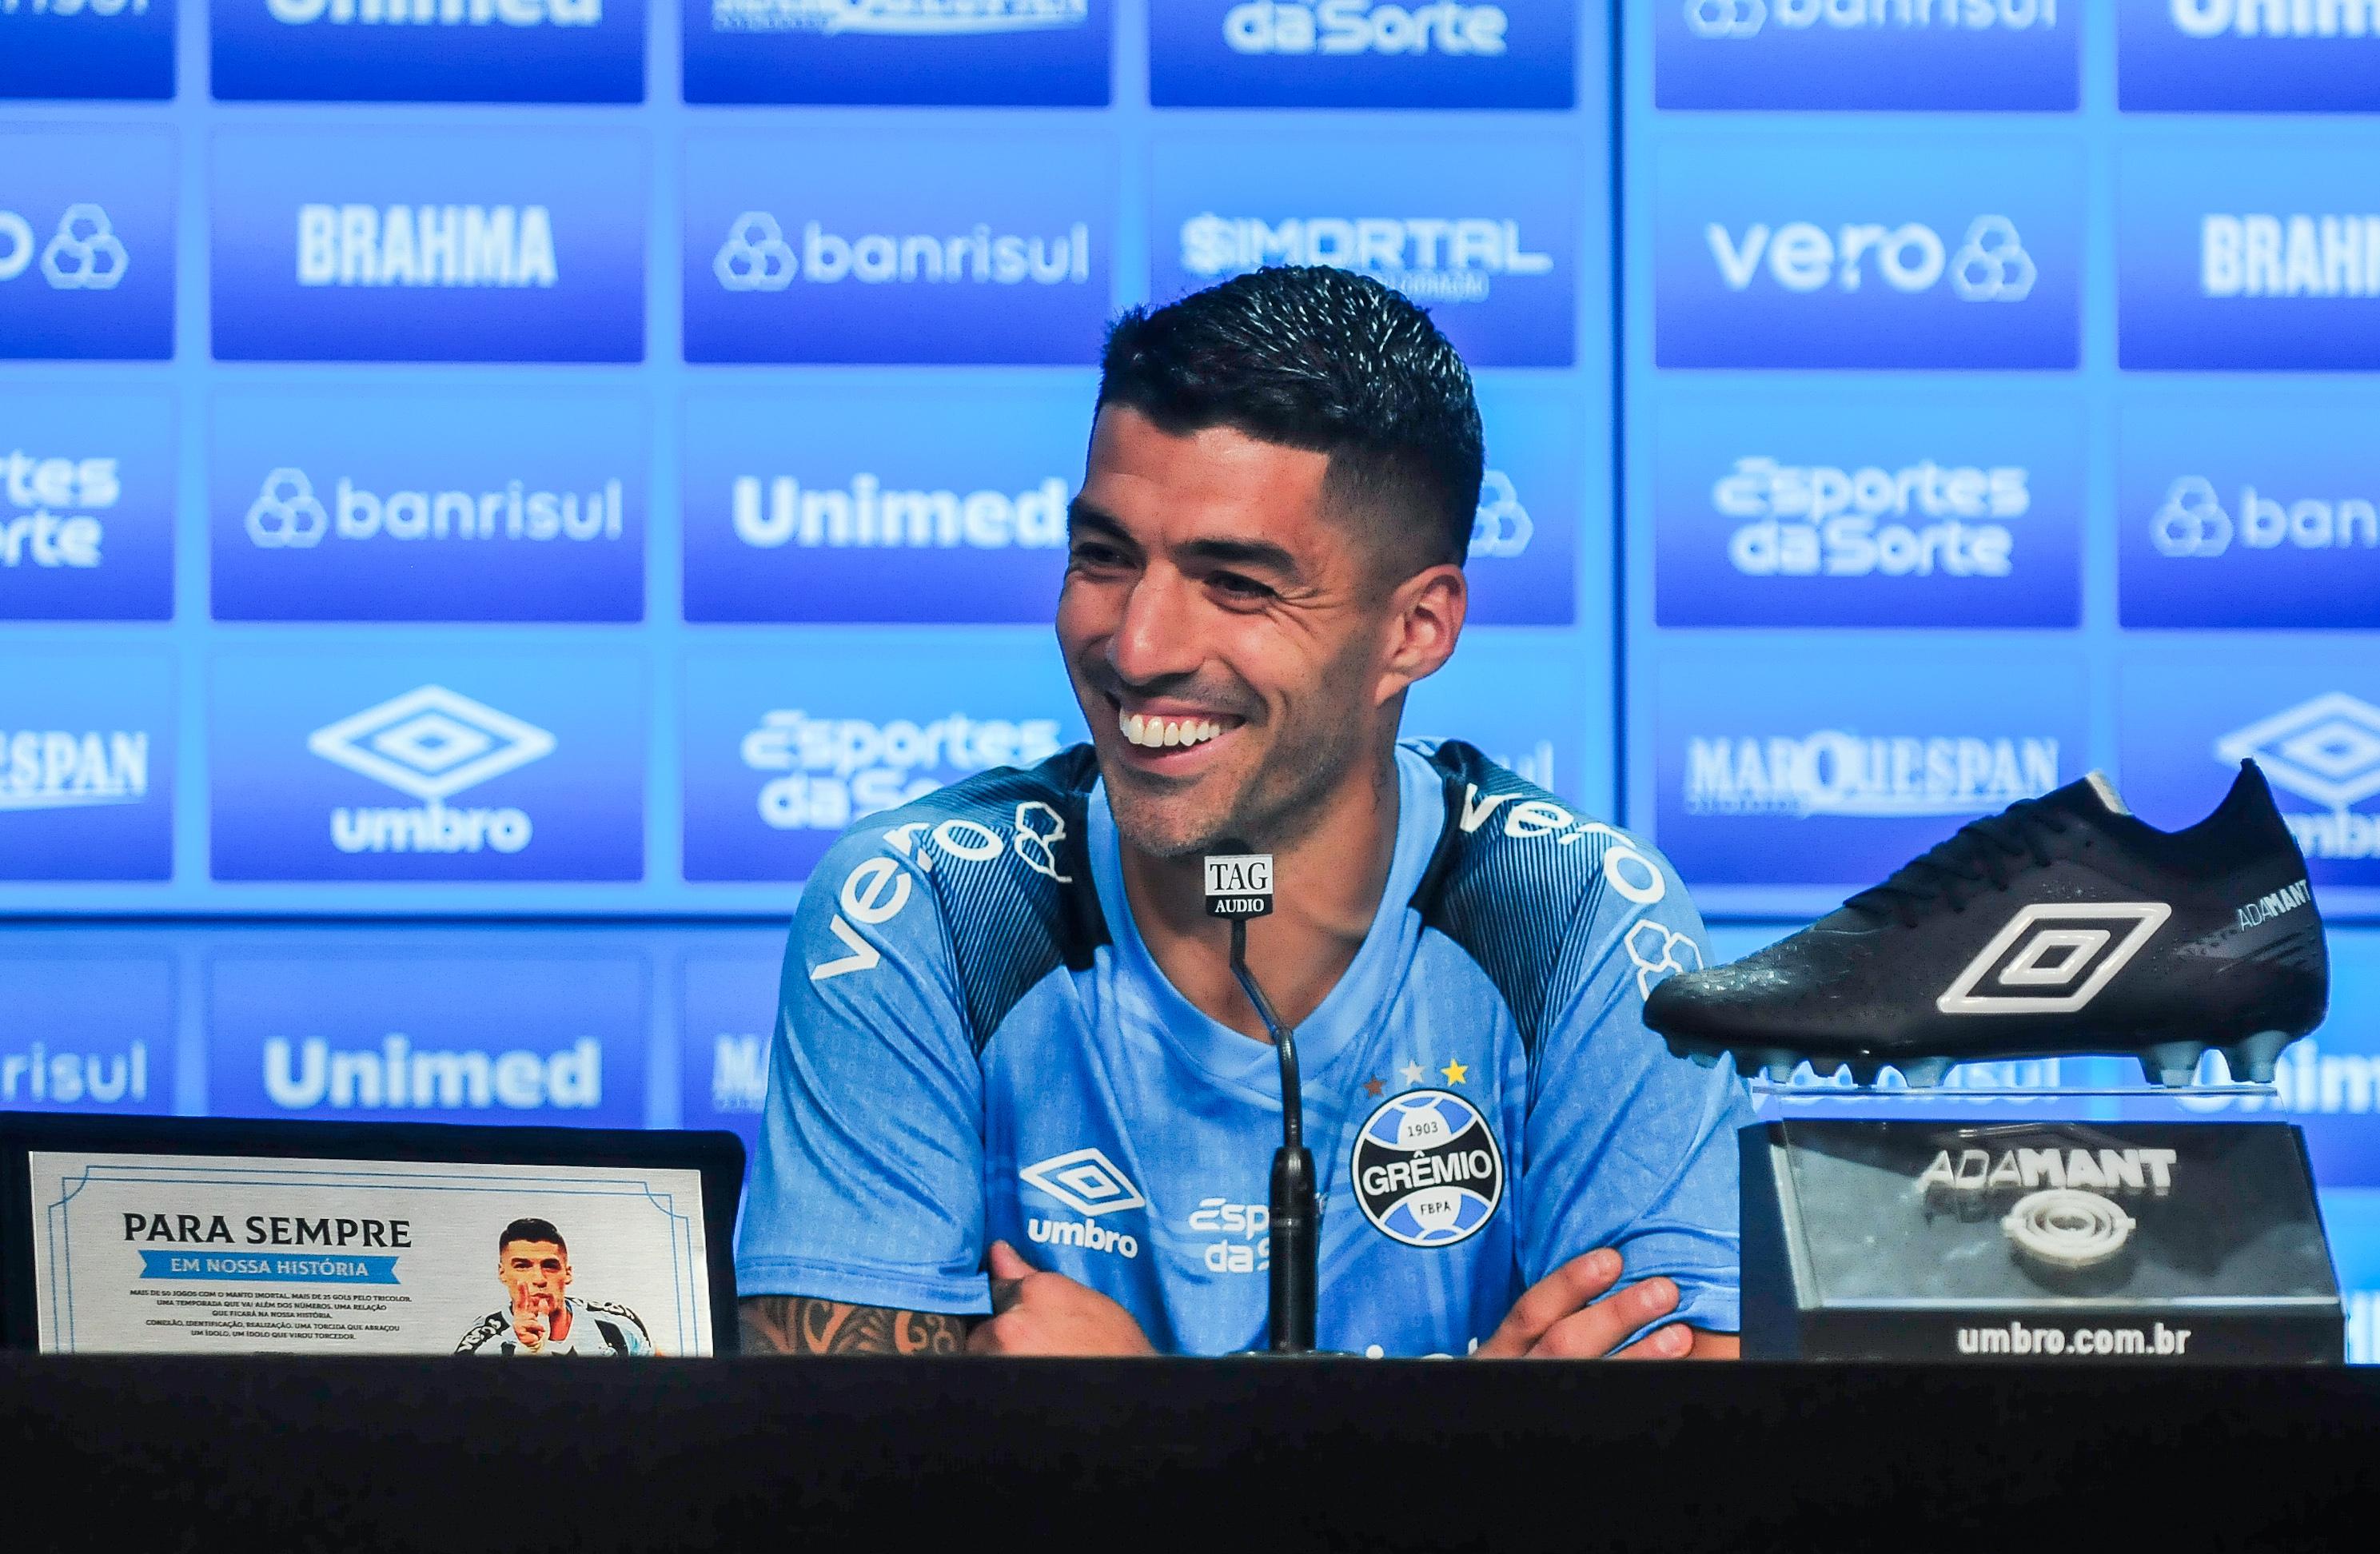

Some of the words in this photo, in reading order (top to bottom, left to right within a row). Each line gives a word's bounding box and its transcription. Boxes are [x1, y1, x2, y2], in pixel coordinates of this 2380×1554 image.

[297, 205, 558, 287] BRAHMA
[804, 221, 1089, 284] banrisul
[1706, 222, 1946, 291] vero
[2202, 214, 2380, 298] BRAH
[336, 477, 623, 541] banrisul
[732, 472, 1069, 548] Unimed
[1688, 729, 2058, 803] MARQUESPAN
[330, 802, 533, 853] umbro
[1458, 783, 1665, 904] vero
[810, 818, 1004, 980] vero
[1210, 861, 1268, 892] TAG
[1215, 899, 1264, 914] AUDIO
[2237, 879, 2311, 931] ADAMANT
[262, 1033, 603, 1110] Unimed
[1408, 1122, 1438, 1137] 1903
[1362, 1150, 1493, 1196] GRÊMIO
[1916, 1148, 2177, 1195] ADAMANT
[123, 1213, 236, 1244] PARA
[246, 1217, 413, 1249] SEMPRE
[1421, 1201, 1451, 1215] FBPA
[1027, 1217, 1138, 1259] umbro
[170, 1257, 201, 1273] EM
[206, 1259, 272, 1274] NOSSA
[277, 1258, 369, 1277] HISTÓRIA
[1958, 1324, 2191, 1355] umbro.com.br
